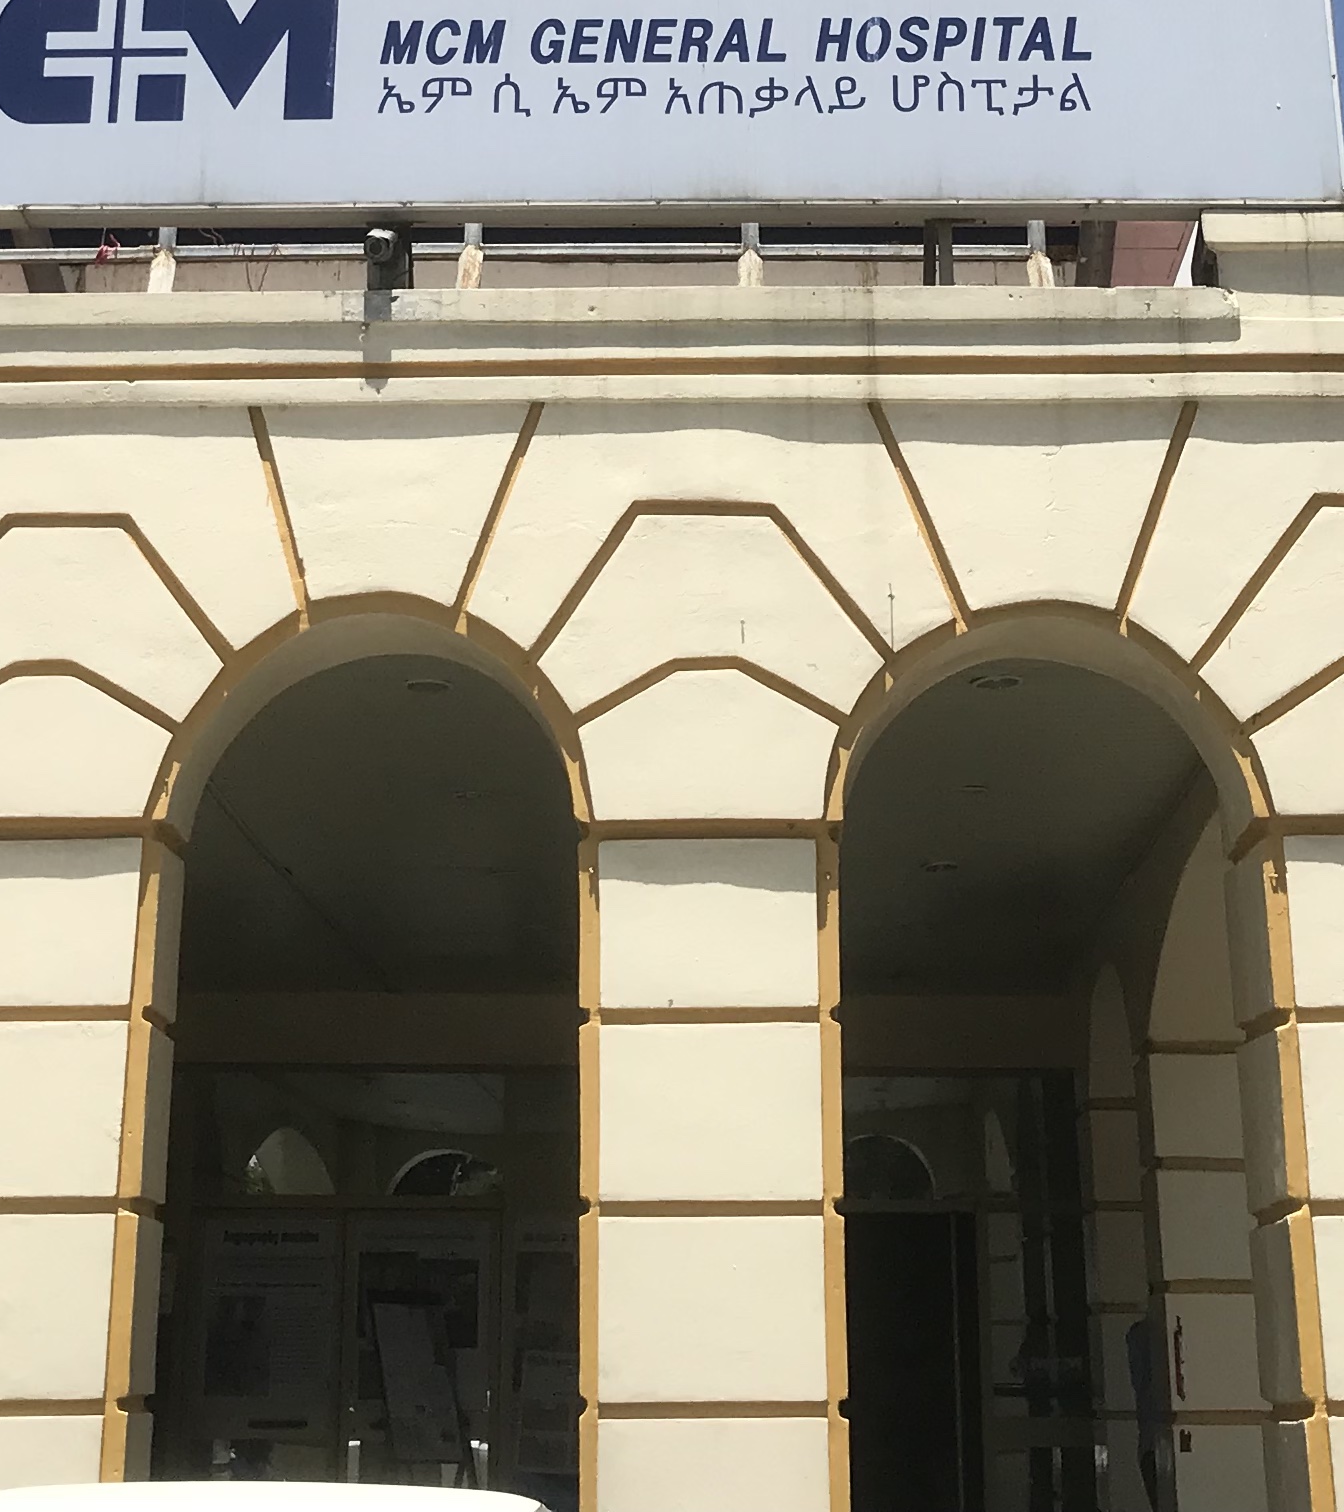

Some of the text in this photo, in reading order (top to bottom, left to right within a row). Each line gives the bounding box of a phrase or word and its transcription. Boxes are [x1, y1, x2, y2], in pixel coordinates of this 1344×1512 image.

[380, 16, 1093, 65] MCM GENERAL HOSPITAL
[378, 71, 1093, 119] ኤም ሲ ኤም አጠቃላይ ሆስፒታል
